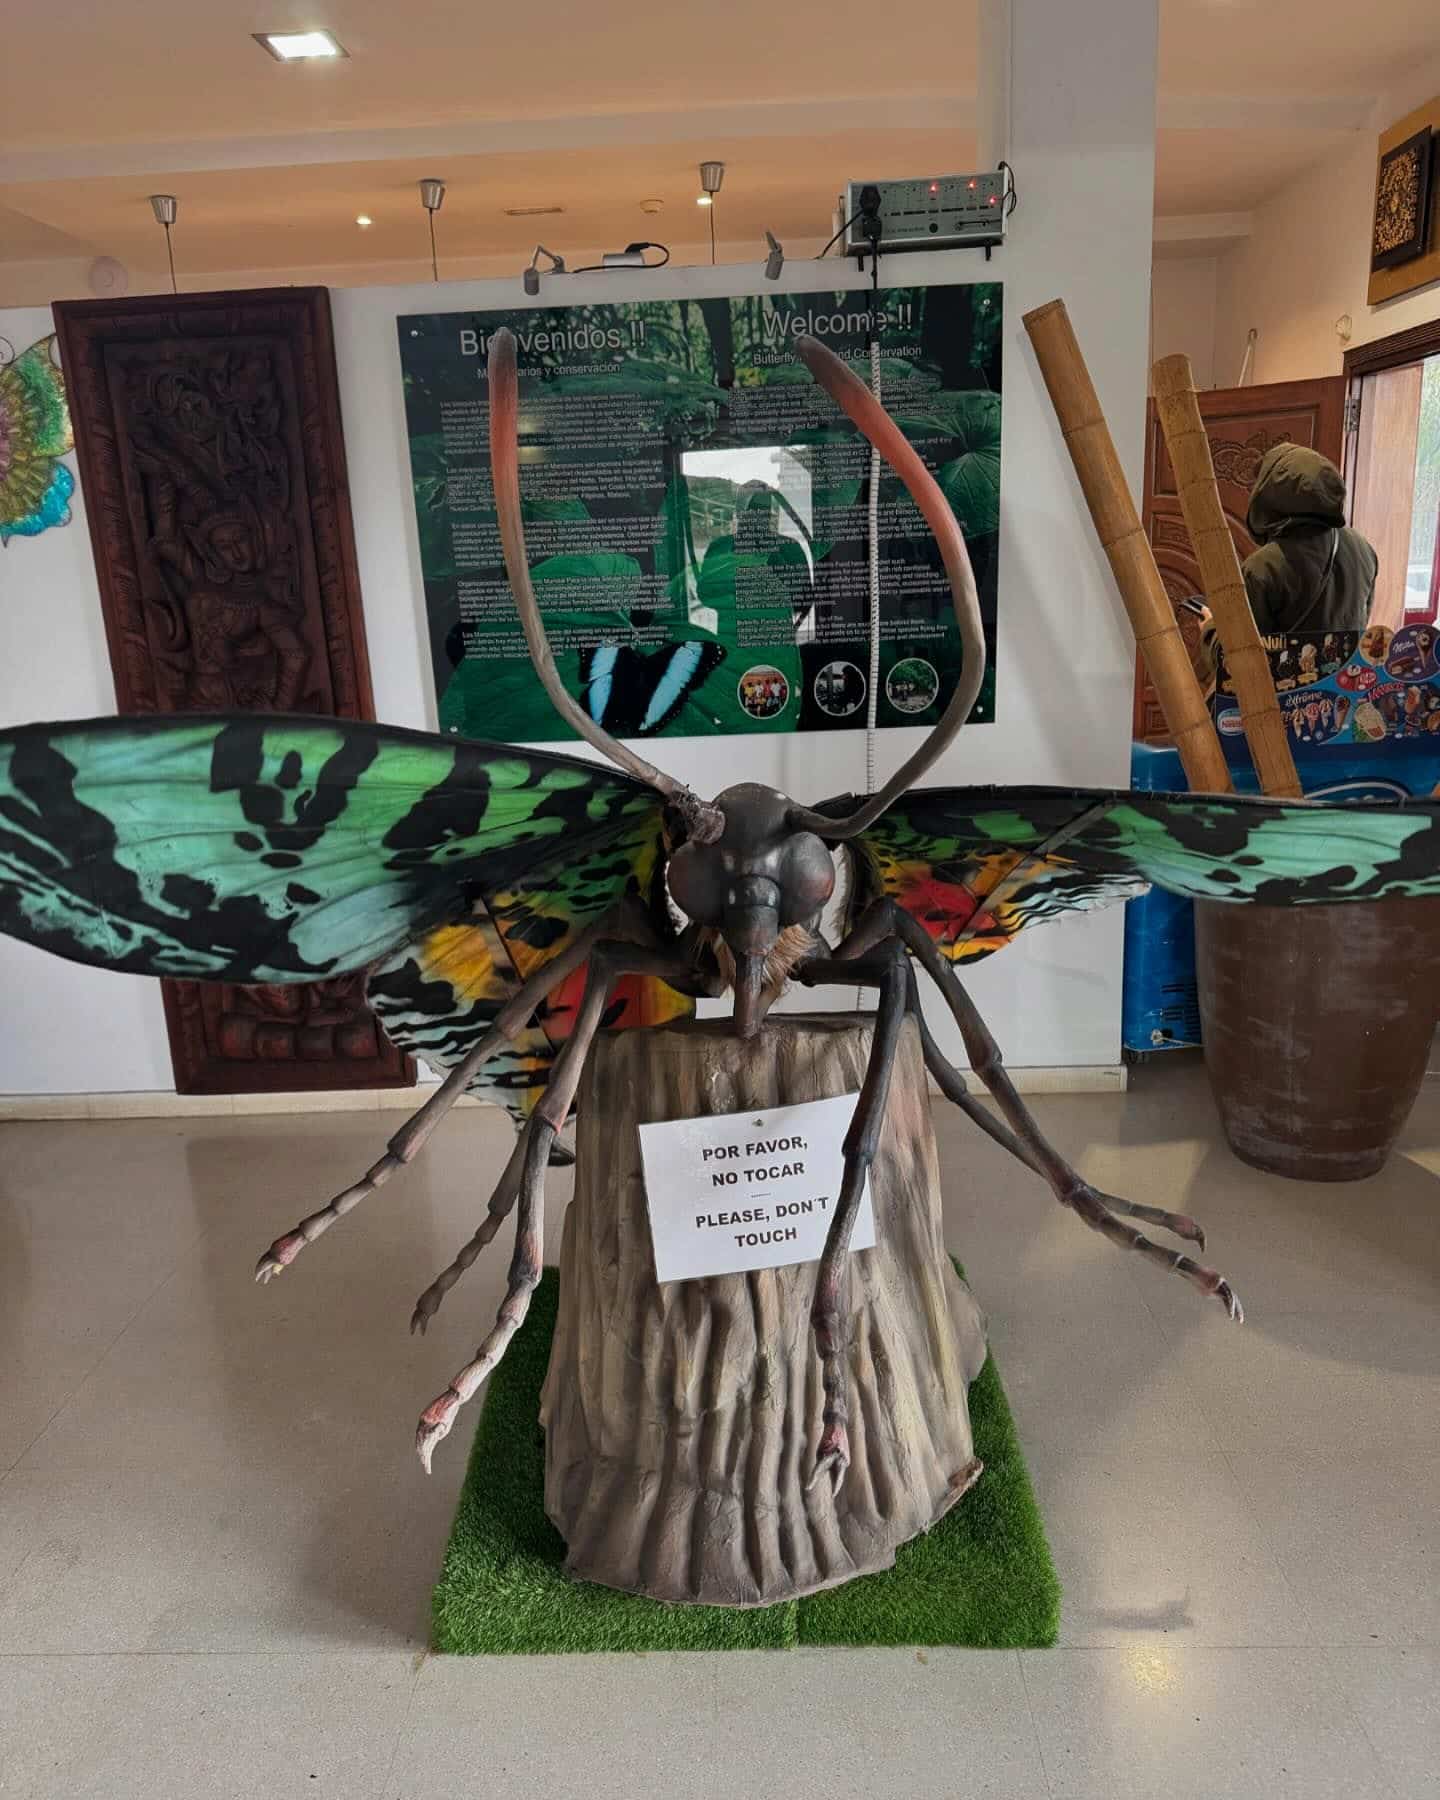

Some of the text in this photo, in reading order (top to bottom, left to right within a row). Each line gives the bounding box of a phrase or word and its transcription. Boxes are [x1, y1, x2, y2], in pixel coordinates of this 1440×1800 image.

[702, 1136, 808, 1161] POR FAVOR,
[712, 1162, 805, 1187] NO TOCAR
[695, 1208, 770, 1228] PLEASE,
[734, 1227, 797, 1248] TOUCH
